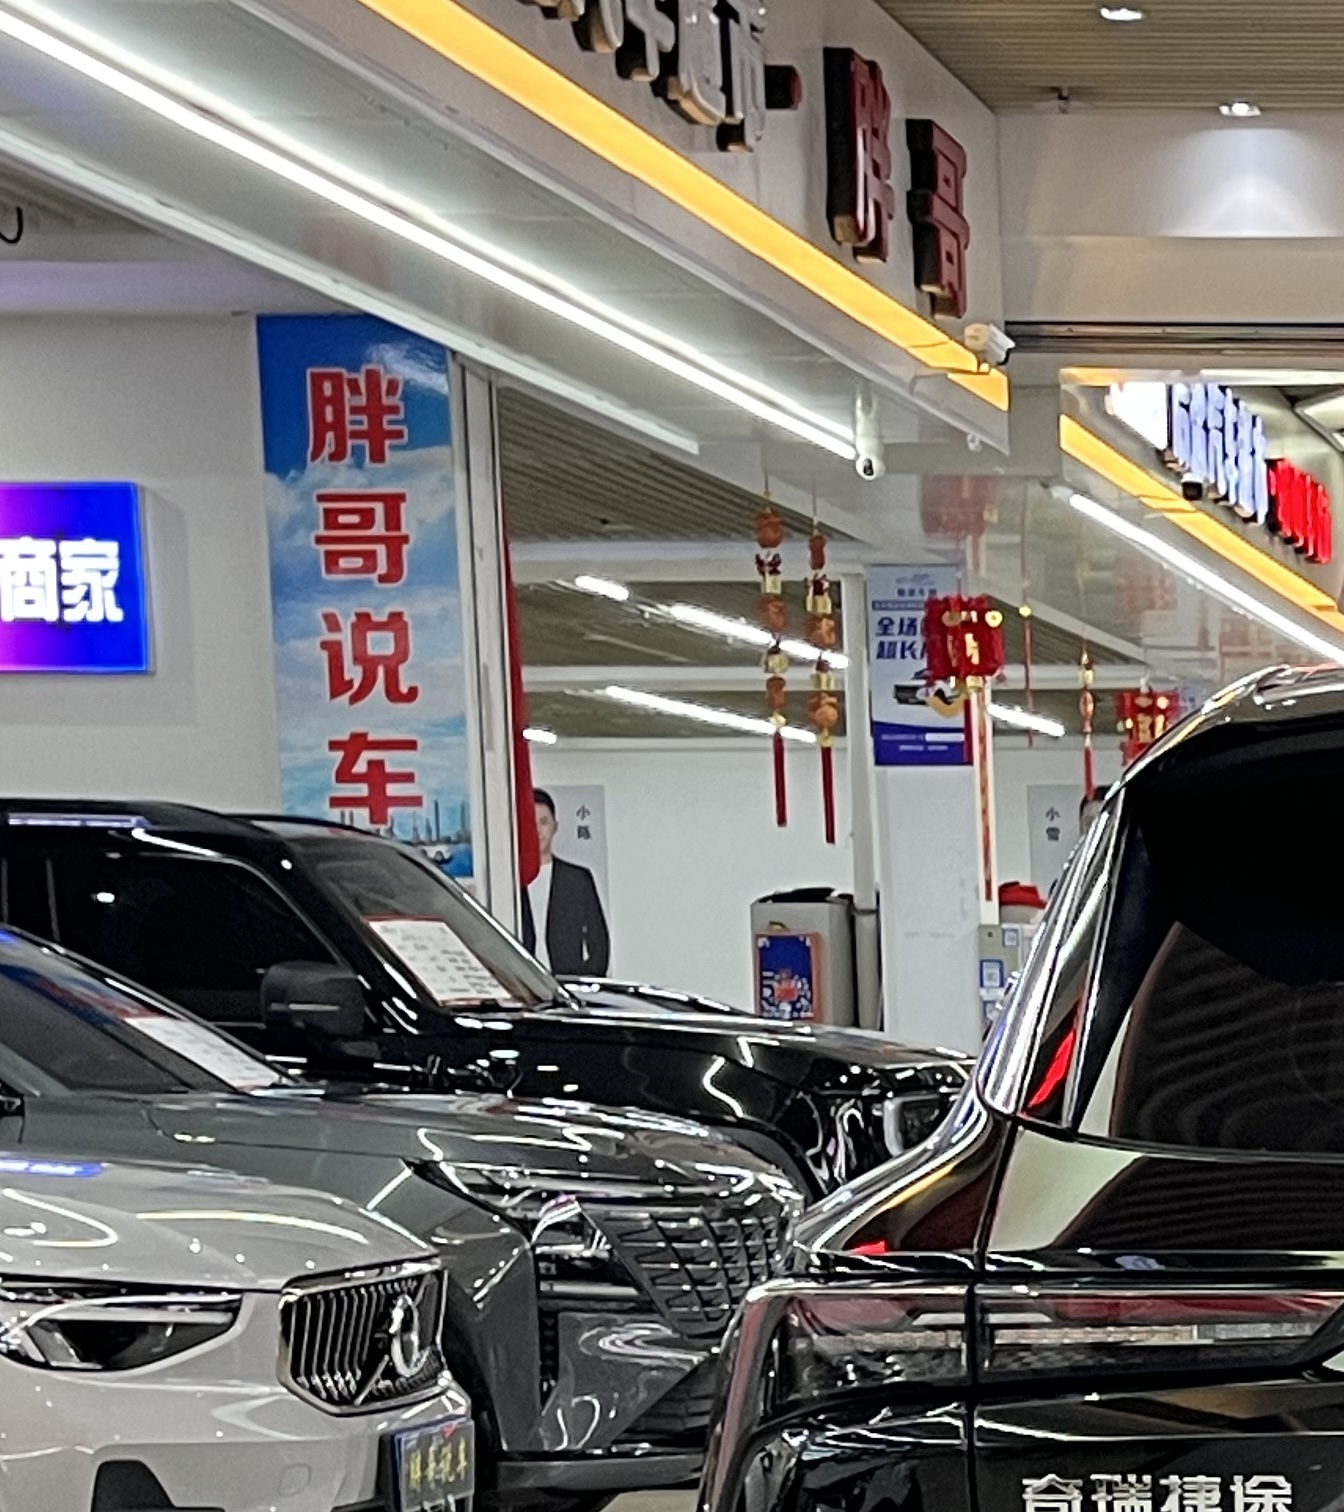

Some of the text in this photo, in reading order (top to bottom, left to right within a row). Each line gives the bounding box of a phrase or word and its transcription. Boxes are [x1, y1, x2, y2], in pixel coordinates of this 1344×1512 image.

[0, 535, 124, 623] 商家
[306, 366, 423, 826] 胖哥说车
